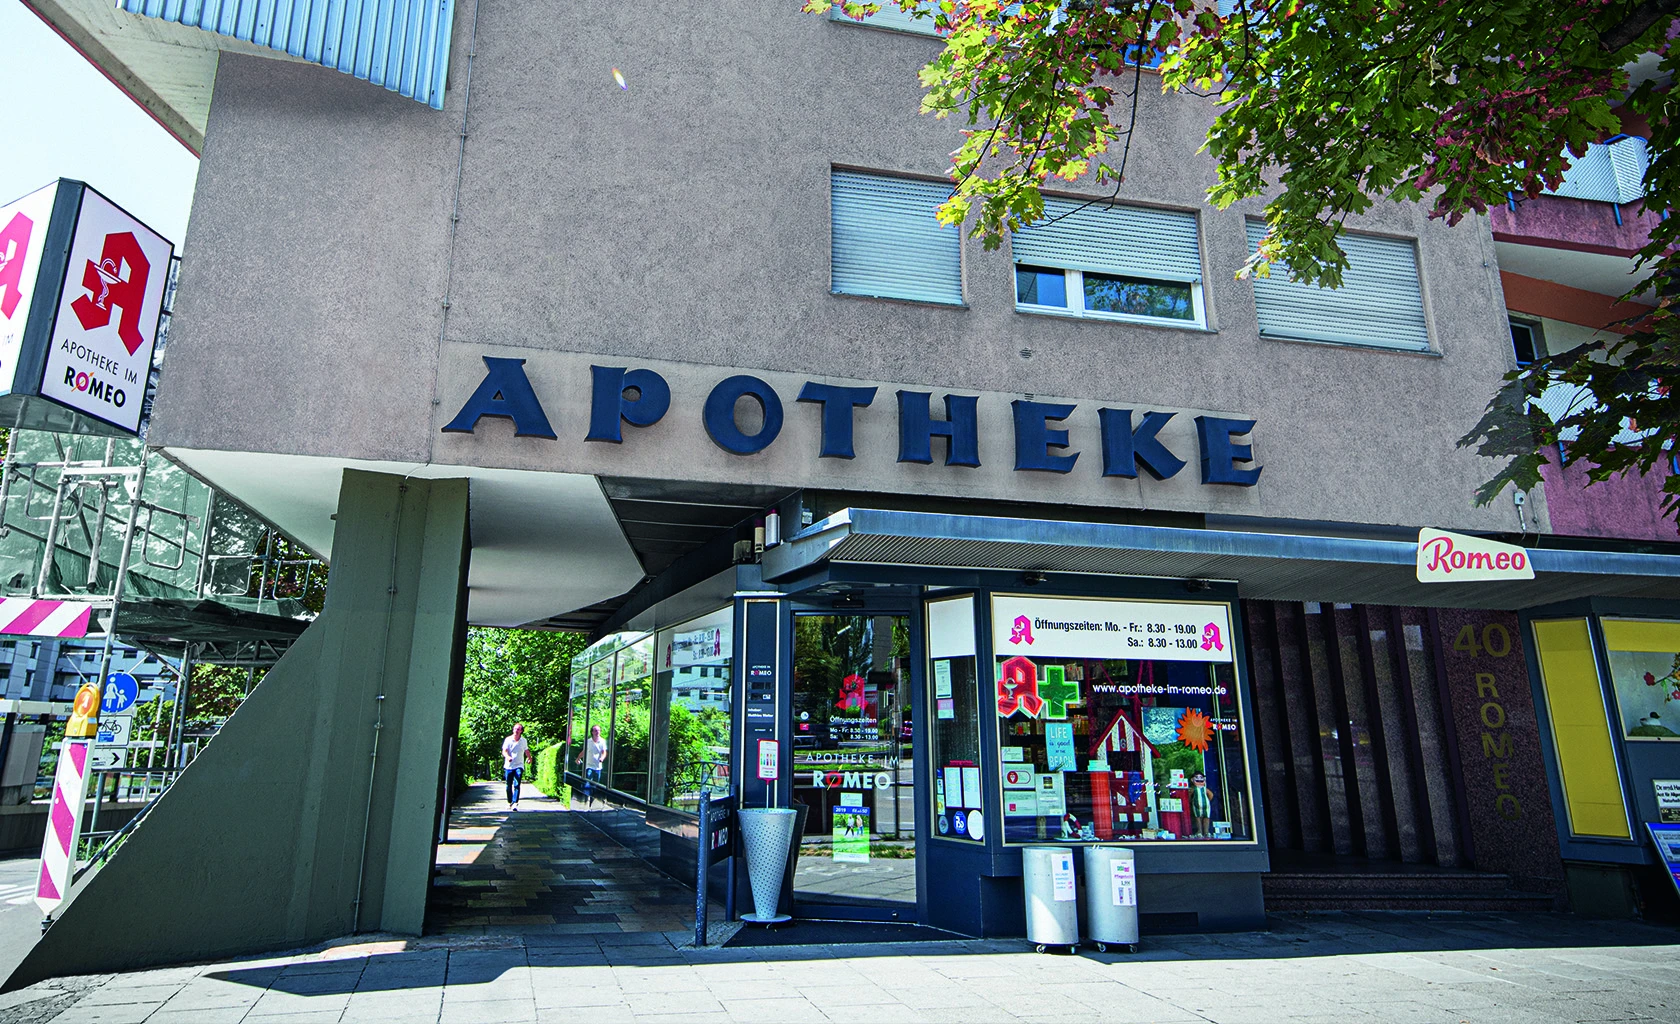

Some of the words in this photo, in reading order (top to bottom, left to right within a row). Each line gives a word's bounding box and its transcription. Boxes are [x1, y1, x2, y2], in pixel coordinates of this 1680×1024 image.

[61, 338, 119, 376] APOTHEKE
[124, 368, 138, 384] IM
[63, 366, 126, 408] ROMEO
[441, 355, 1263, 487] APOTHEKE
[1422, 536, 1526, 574] Romeo
[1034, 616, 1103, 633] Öffnungszeiten:
[1104, 621, 1121, 632] Mo.
[1129, 622, 1143, 633] Fr.:
[1146, 623, 1166, 634] 8.30
[1174, 624, 1196, 634] 19.00
[1127, 636, 1144, 648] Sa.:
[1148, 637, 1167, 648] 8.30
[1175, 638, 1197, 649] 13.00
[1453, 623, 1511, 658] 40
[1092, 683, 1227, 695] www.apotheke-im-romeo.de
[1050, 727, 1068, 739] LIFE
[1212, 723, 1237, 731] ROMEO
[1056, 739, 1071, 748] good
[1475, 672, 1522, 821] ROMEO
[806, 752, 874, 764] APOTHEKE
[884, 755, 899, 766] IM
[1049, 756, 1074, 768] BEACH
[812, 769, 891, 790] ROMEO
